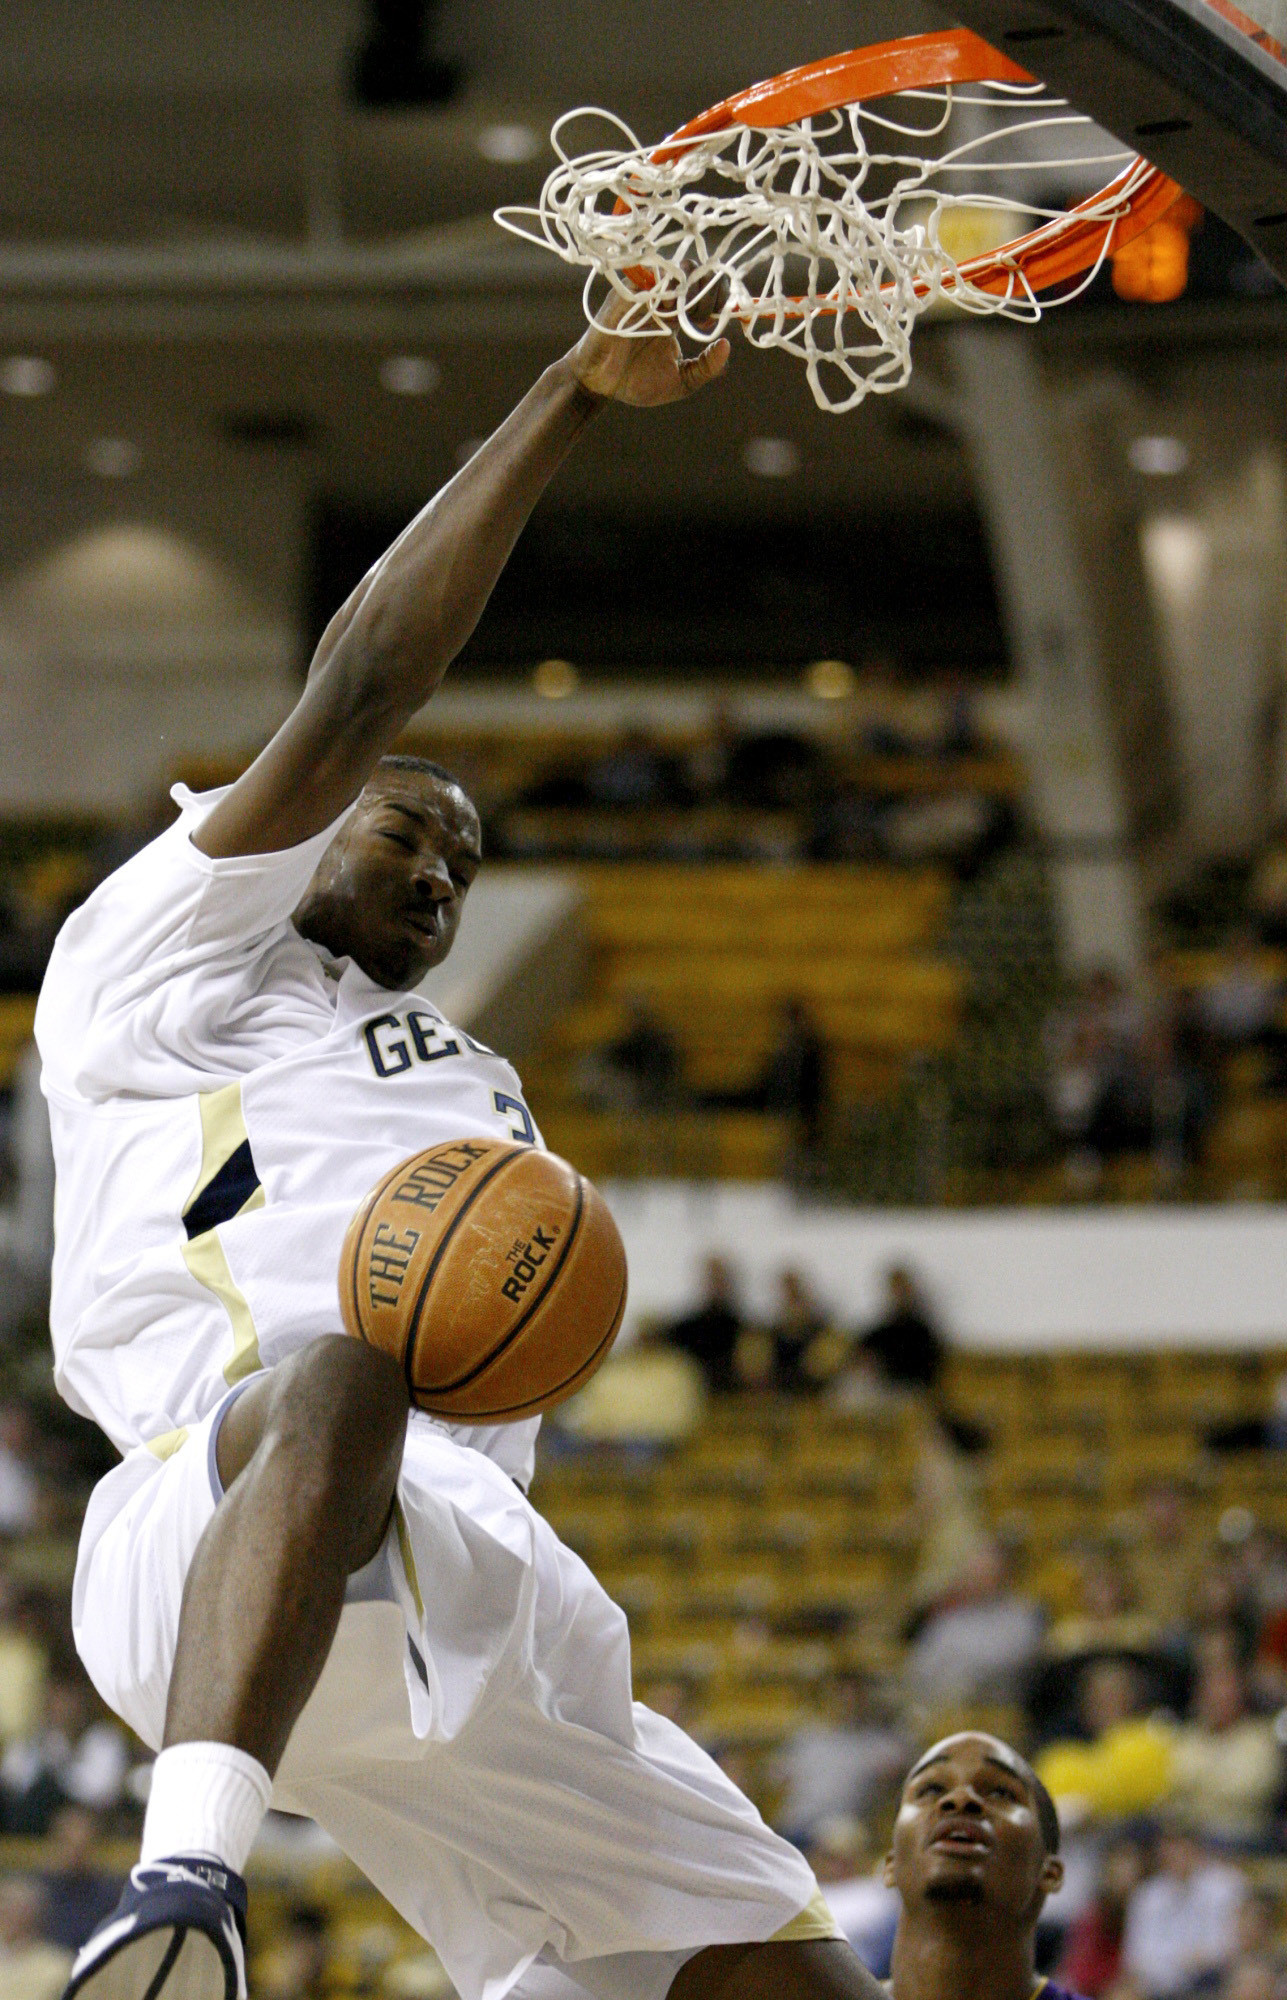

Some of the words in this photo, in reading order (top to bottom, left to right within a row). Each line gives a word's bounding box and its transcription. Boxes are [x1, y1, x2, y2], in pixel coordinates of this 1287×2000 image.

[391, 1142, 490, 1213] ROCK
[370, 1223, 421, 1308] THE
[501, 1225, 556, 1304] ROCK
[505, 1239, 526, 1263] THE
